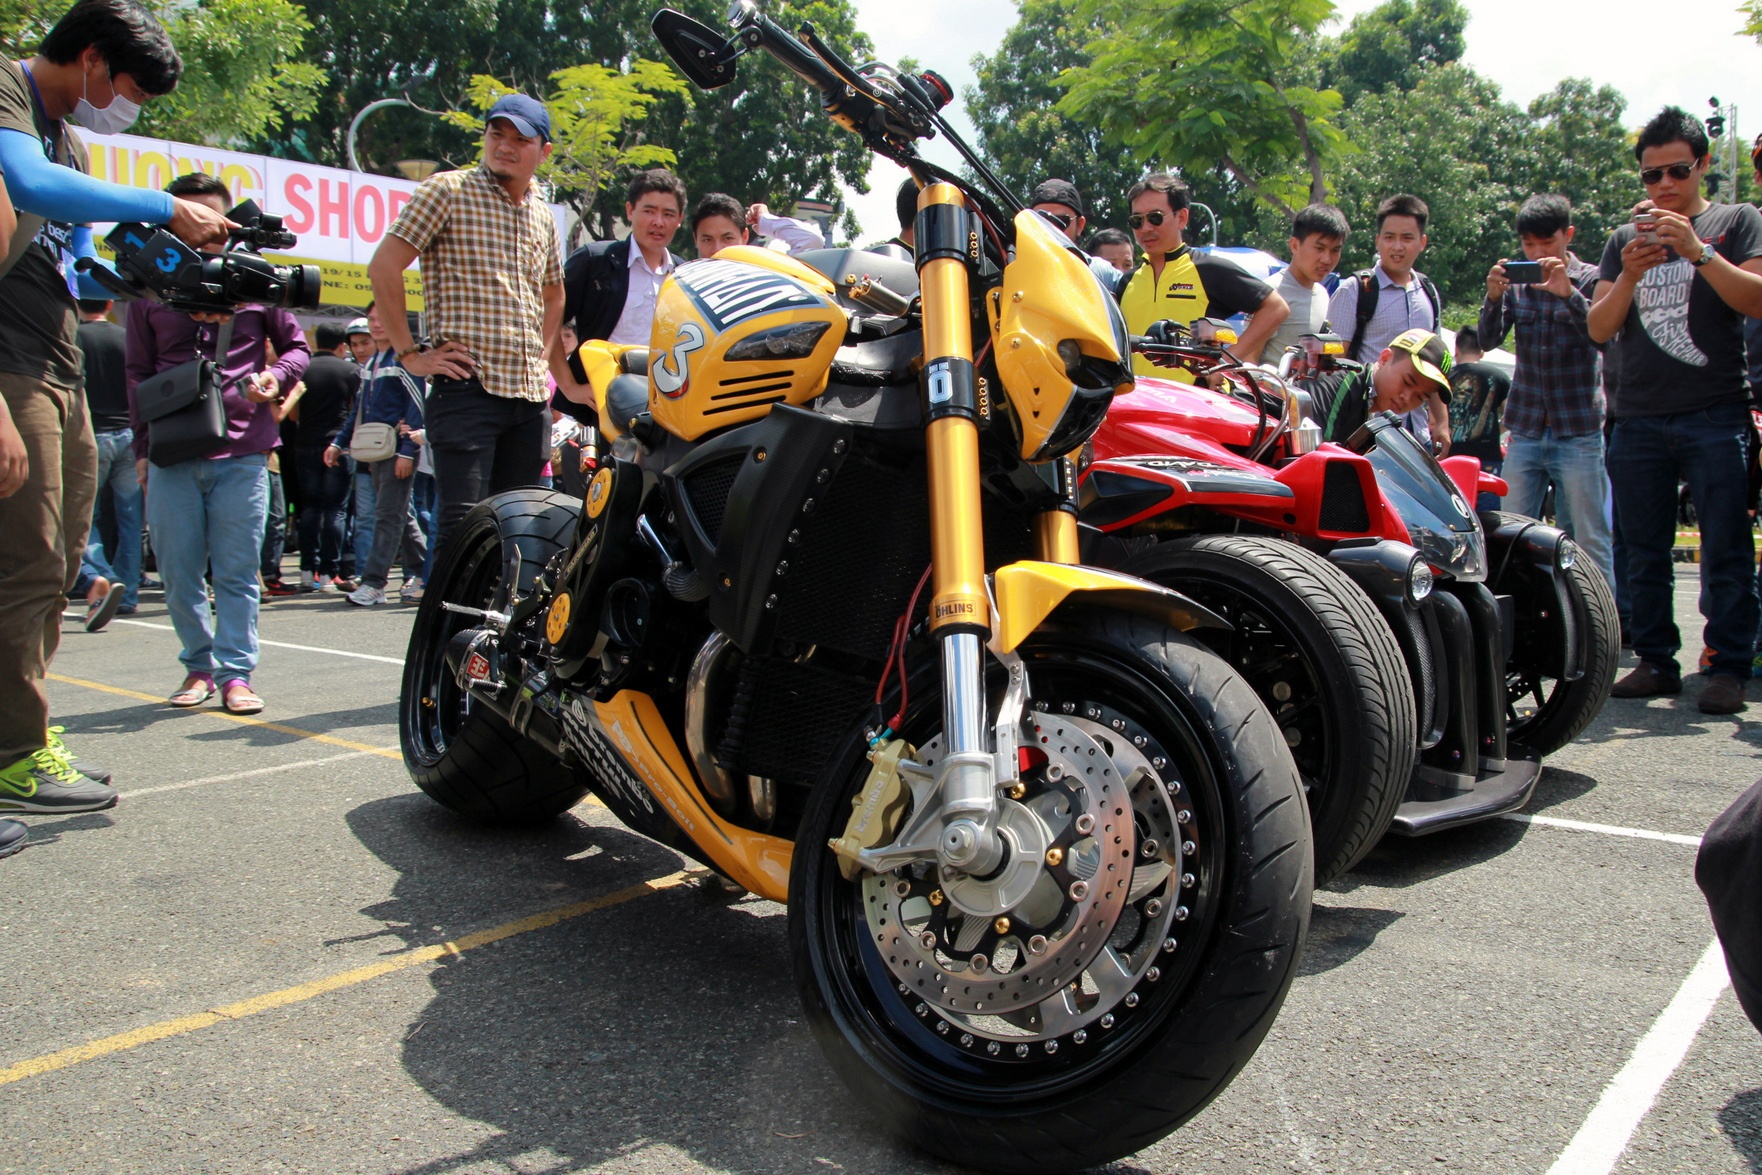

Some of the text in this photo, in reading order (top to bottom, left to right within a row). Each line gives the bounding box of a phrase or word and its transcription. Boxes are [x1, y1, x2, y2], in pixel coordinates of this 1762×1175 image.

[124, 231, 146, 250] 1
[156, 248, 182, 273] 3
[1639, 282, 1687, 309] BOARD
[651, 322, 705, 400] 3
[588, 722, 654, 814] brembo
[855, 781, 884, 833] brembo
